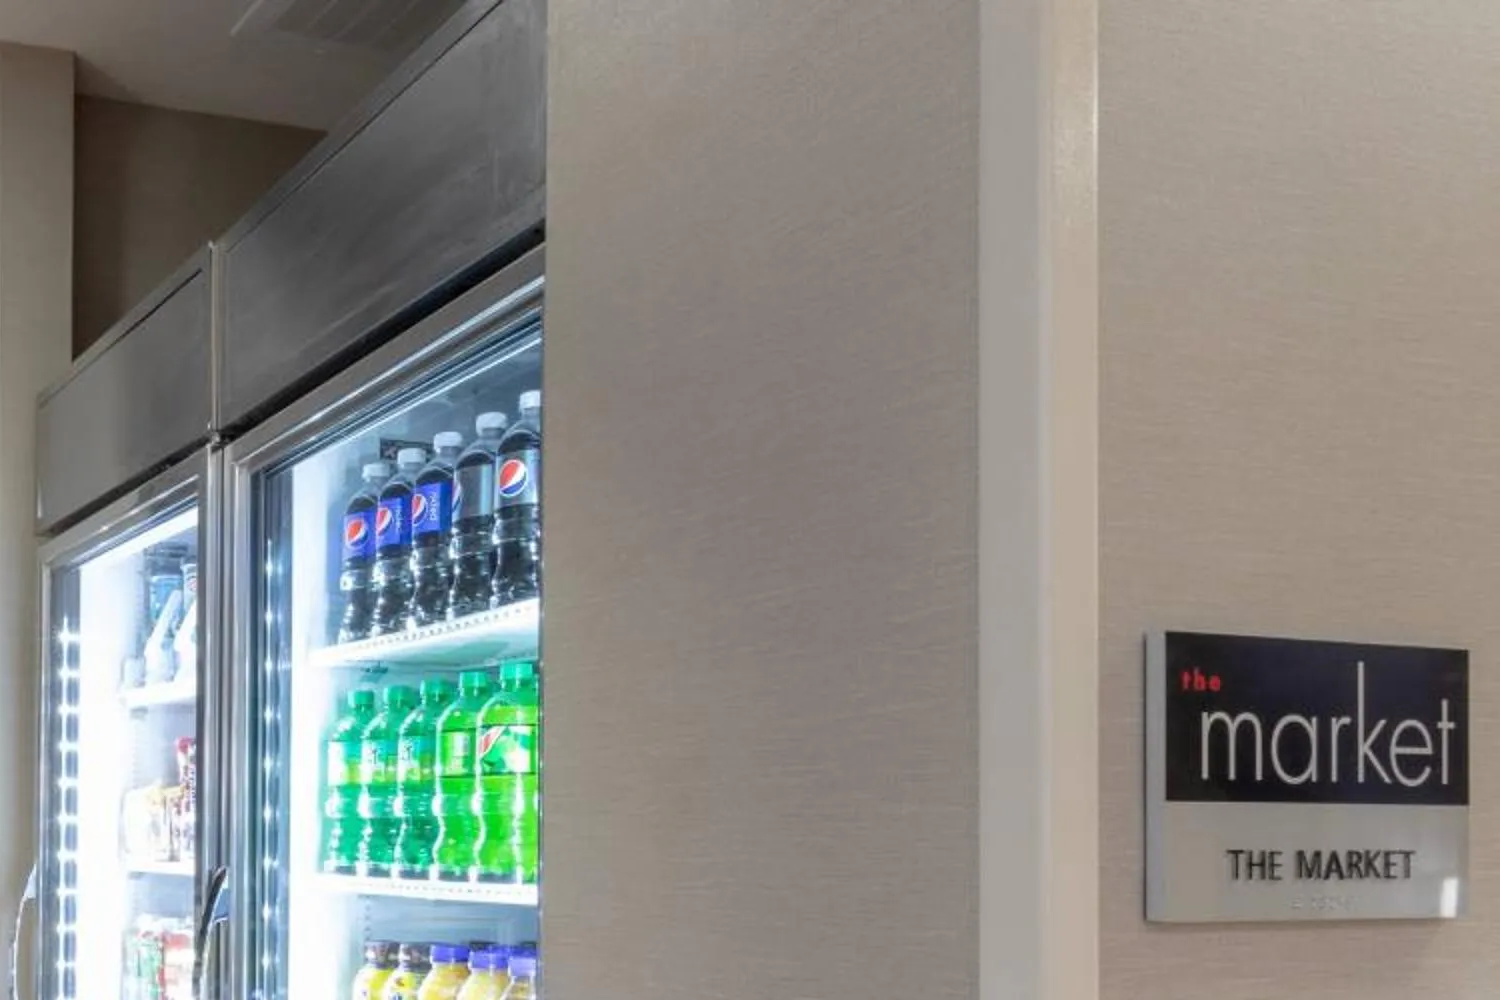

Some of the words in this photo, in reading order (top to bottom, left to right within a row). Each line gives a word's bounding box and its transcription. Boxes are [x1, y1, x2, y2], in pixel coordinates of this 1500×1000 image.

[1181, 667, 1221, 691] the
[1201, 660, 1457, 787] market
[1226, 849, 1283, 881] THE
[1297, 849, 1417, 881] MARKET
